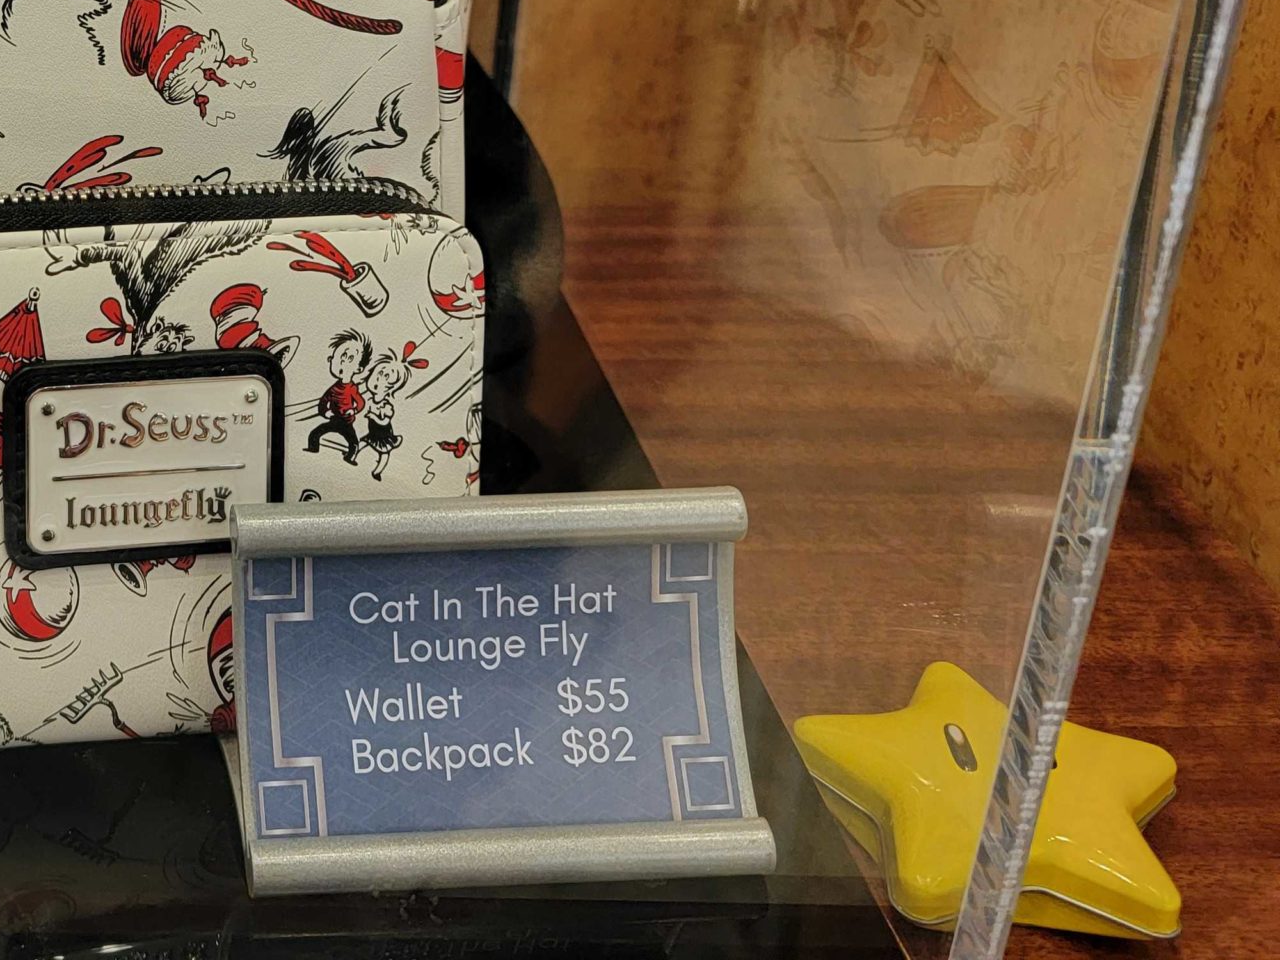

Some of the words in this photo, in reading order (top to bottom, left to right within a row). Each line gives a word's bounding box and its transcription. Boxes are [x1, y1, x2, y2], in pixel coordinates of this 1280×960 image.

[65, 486, 228, 529] loungefly
[348, 591, 419, 625] Cat
[433, 589, 462, 620] In
[475, 583, 539, 618] The
[553, 583, 617, 615] Hat
[392, 630, 526, 670] Lounge
[539, 620, 589, 666] Fly
[345, 682, 463, 726] Wallet
[556, 677, 630, 717] $55
[351, 727, 535, 782] Backpack
[561, 726, 637, 768] $82
